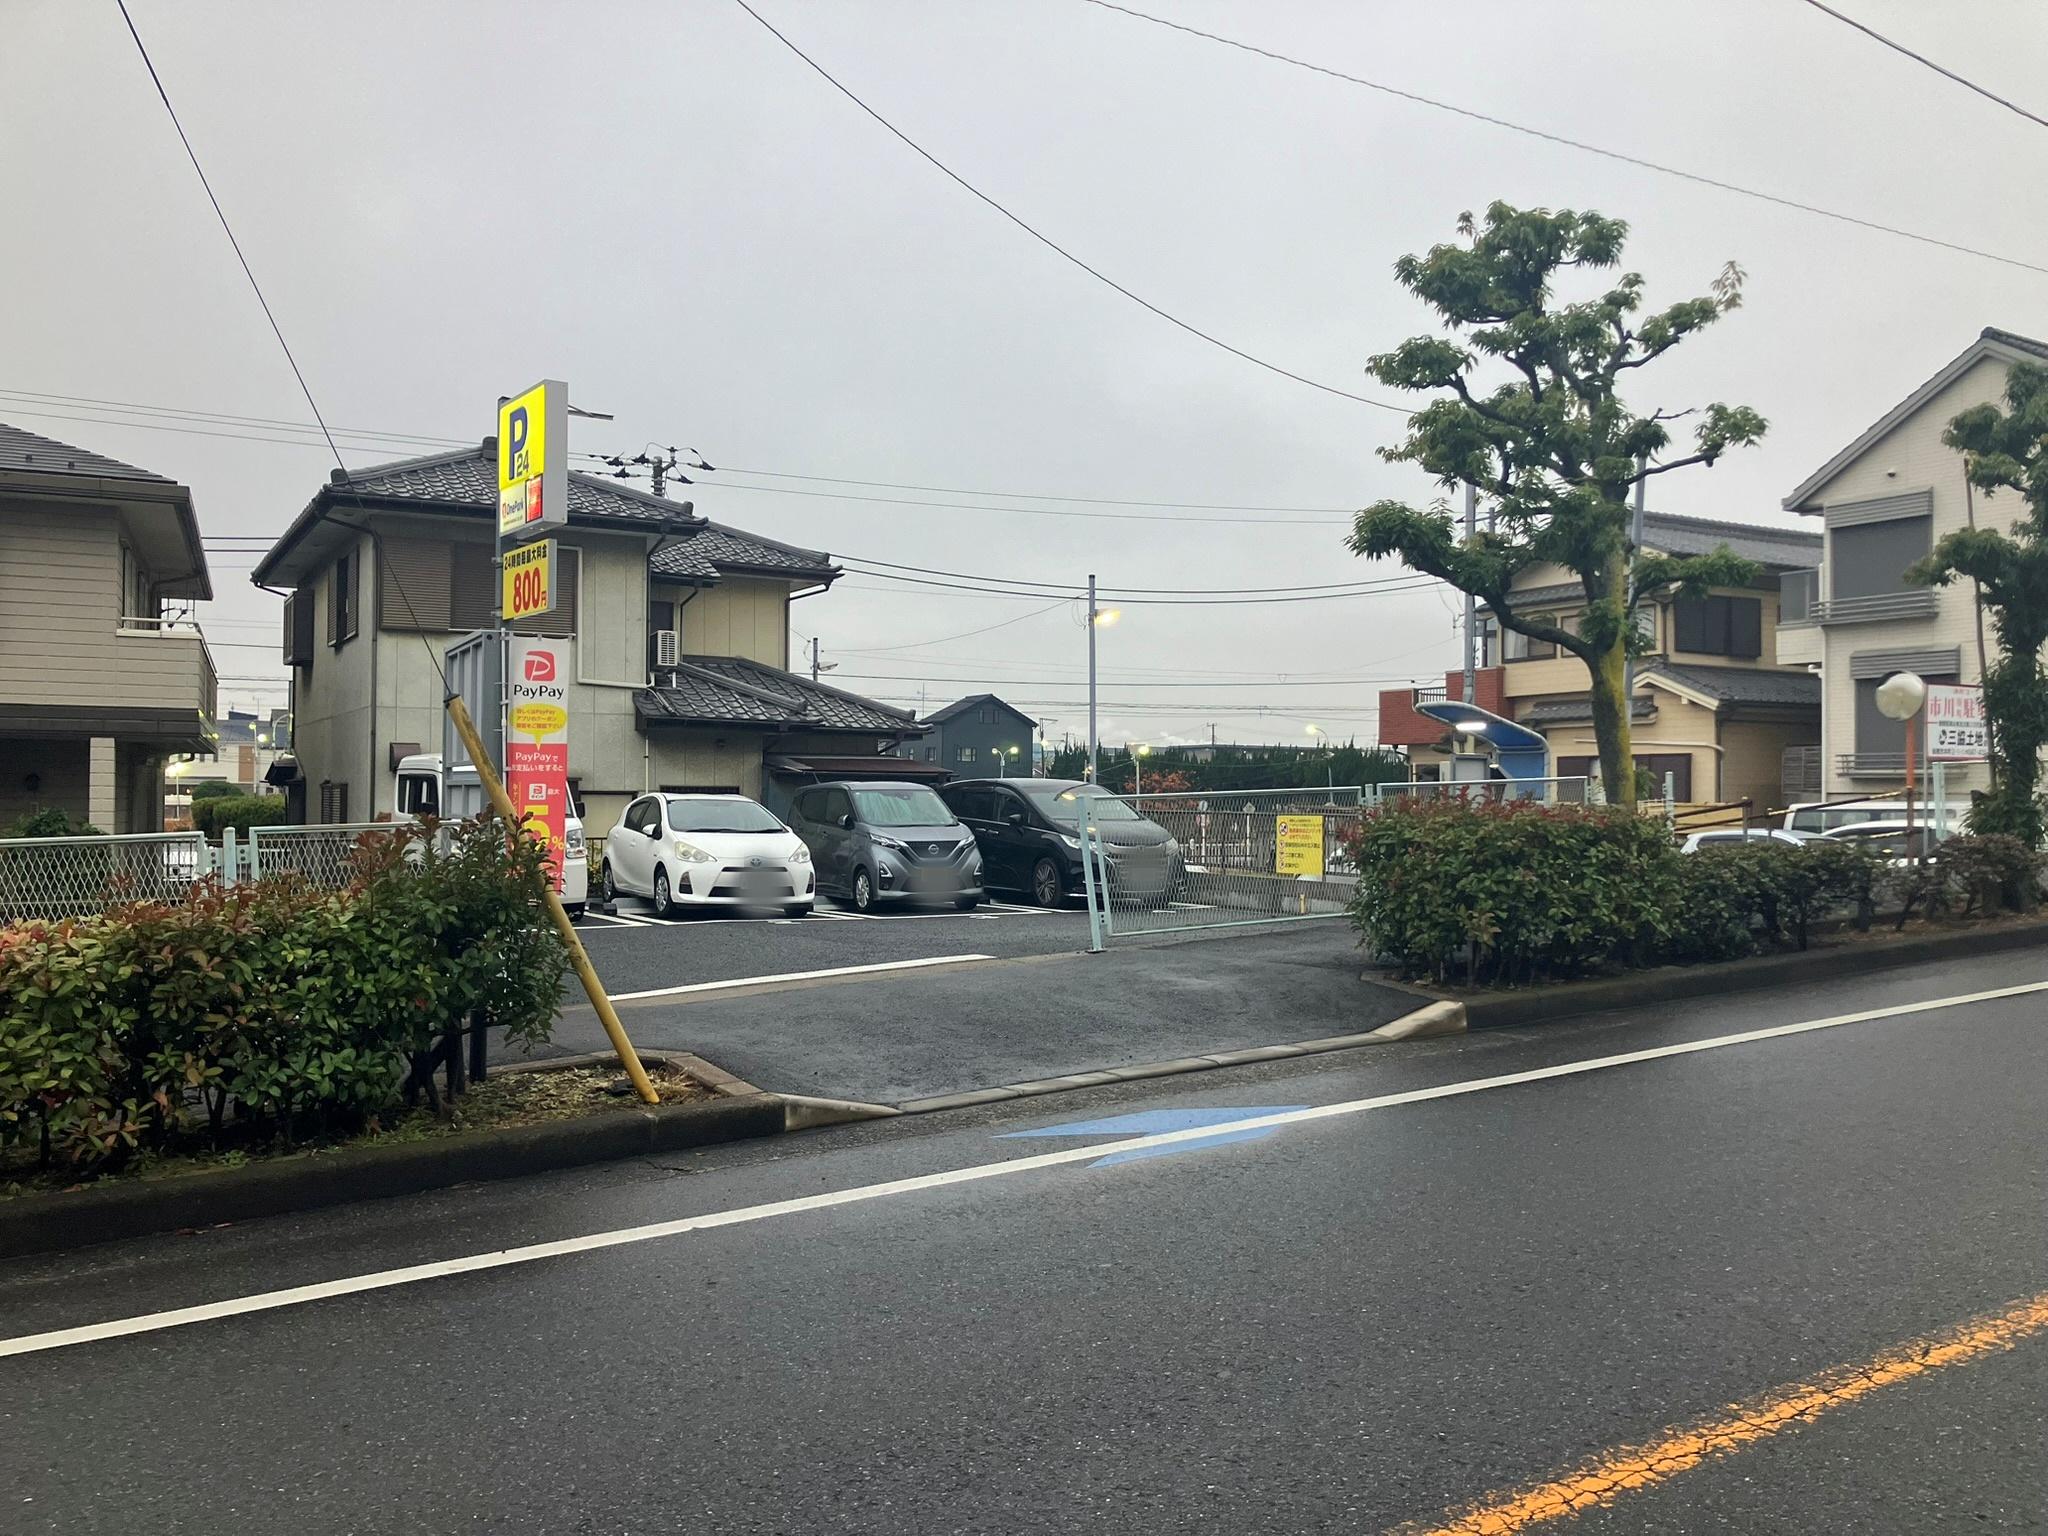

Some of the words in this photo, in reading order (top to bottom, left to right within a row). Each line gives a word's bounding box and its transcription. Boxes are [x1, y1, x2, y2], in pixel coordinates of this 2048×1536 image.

[509, 406, 528, 481] P
[516, 449, 530, 479] 24
[513, 566, 547, 614] 800円
[514, 684, 564, 700] PayPay
[515, 752, 559, 762] PayPayで
